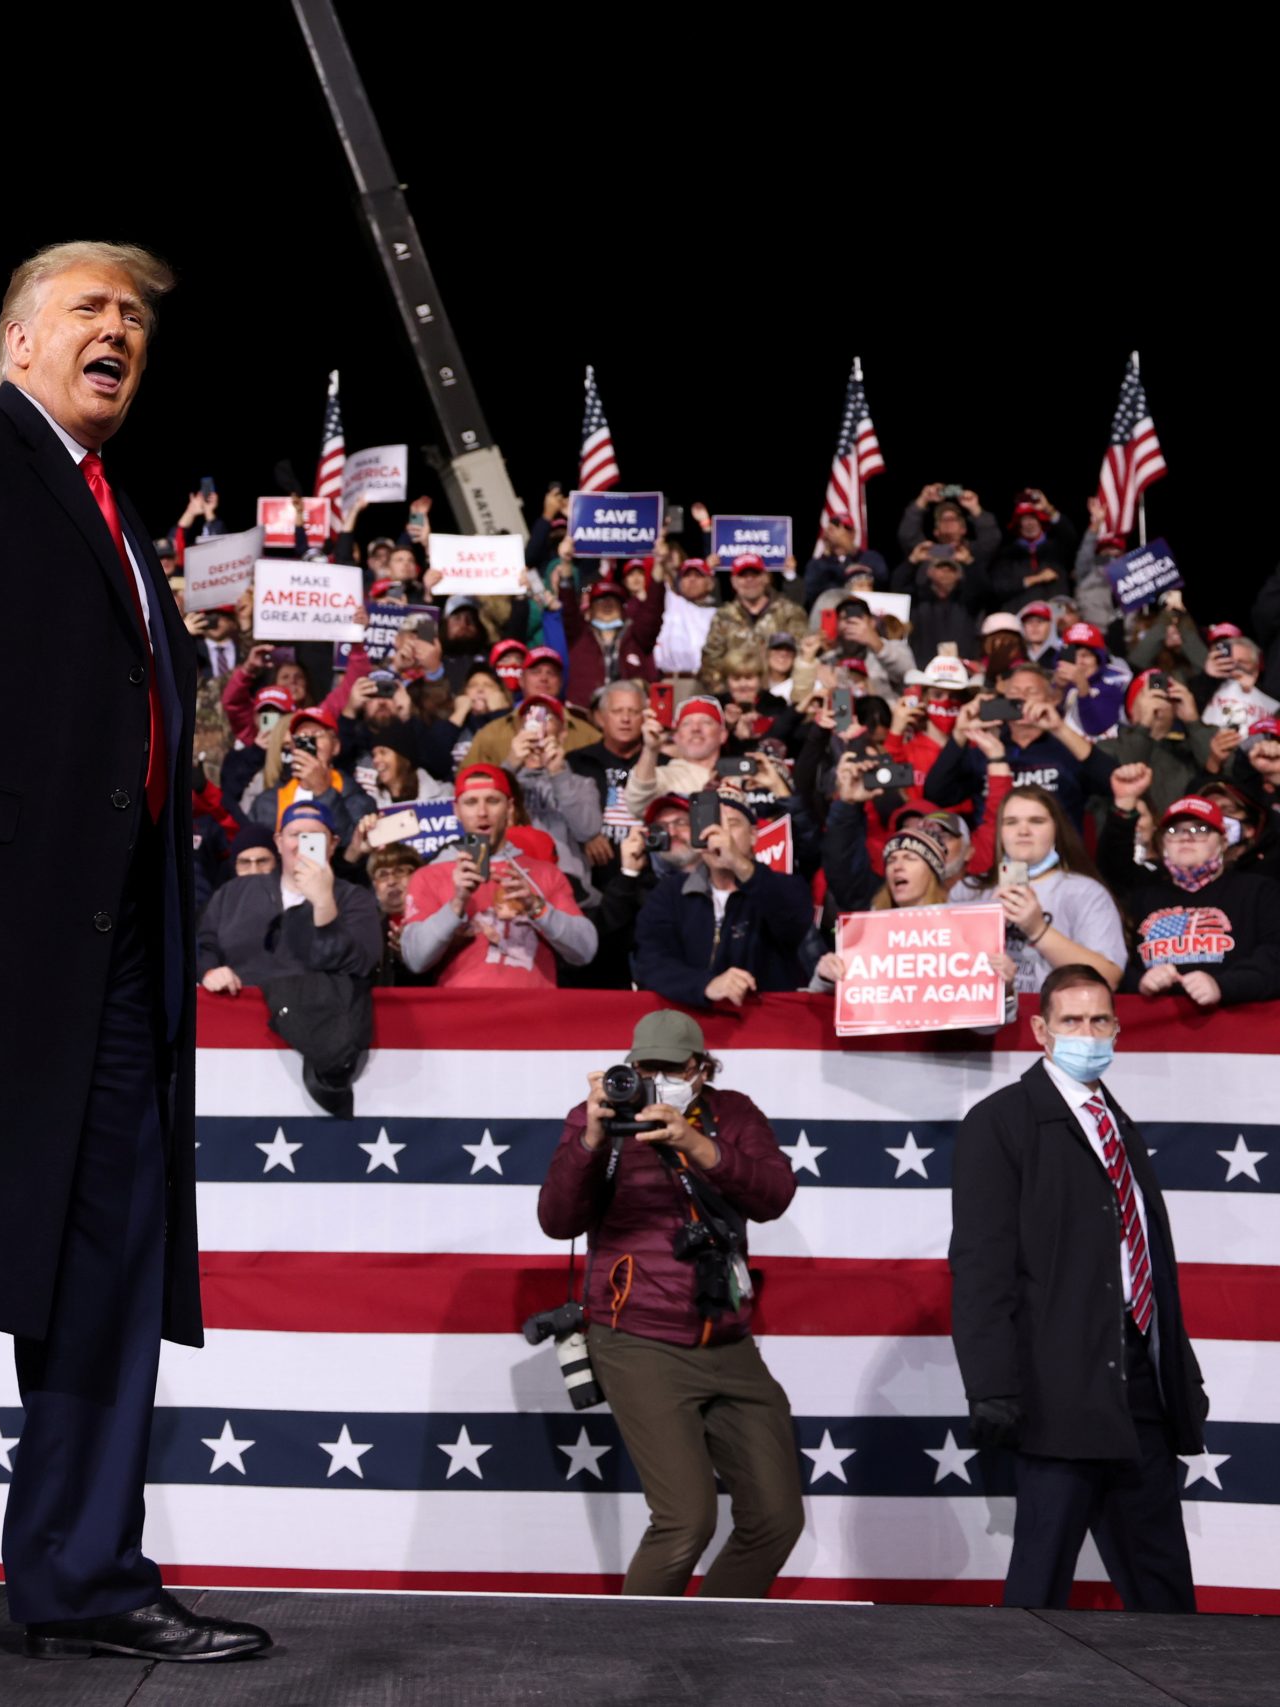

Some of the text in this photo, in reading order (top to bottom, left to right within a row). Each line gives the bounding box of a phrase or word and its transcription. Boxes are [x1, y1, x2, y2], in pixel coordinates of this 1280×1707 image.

[594, 509, 637, 524] SAVE
[574, 526, 655, 542] AMERICA!
[734, 529, 770, 542] SAVE
[457, 552, 496, 561] SAVE
[718, 544, 786, 558] AMERICA!
[290, 576, 330, 588] MAKE
[1117, 556, 1176, 595] AMERICA
[262, 591, 356, 607] AMERICA
[1121, 580, 1156, 604] GREAT
[260, 610, 307, 622] GREAT
[1012, 768, 1059, 788] UMP
[418, 815, 459, 833] AVE
[888, 929, 951, 948] MAKE
[1139, 934, 1234, 961] TRUMP
[846, 951, 995, 981] AMERICA
[845, 983, 994, 1004] GREAT AGAIN
